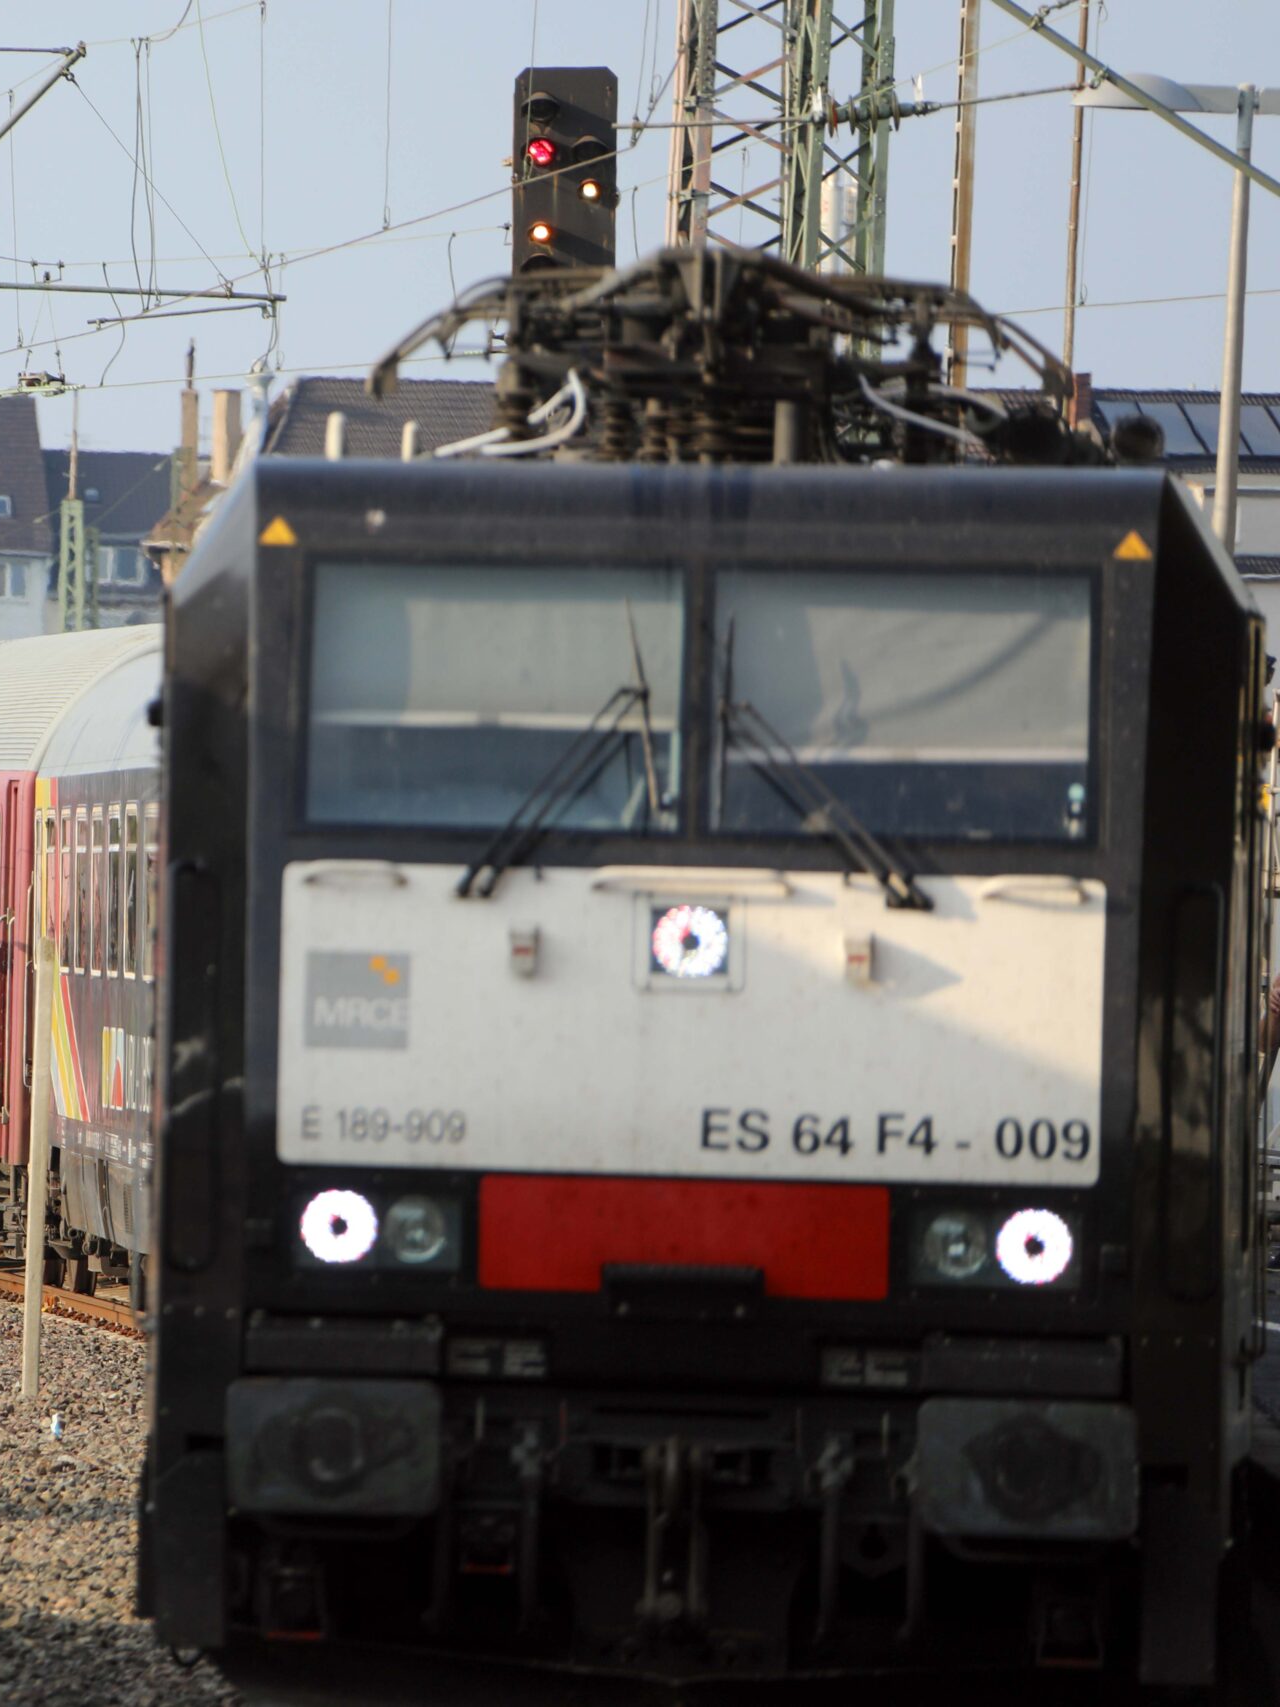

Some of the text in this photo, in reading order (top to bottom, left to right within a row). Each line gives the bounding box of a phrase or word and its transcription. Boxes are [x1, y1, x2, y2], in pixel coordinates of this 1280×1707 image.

[300, 1104, 467, 1145] E 189-909
[700, 1107, 771, 1154] ES
[792, 1112, 855, 1157] 64
[876, 1112, 938, 1157] F4
[994, 1116, 1093, 1162] 009
